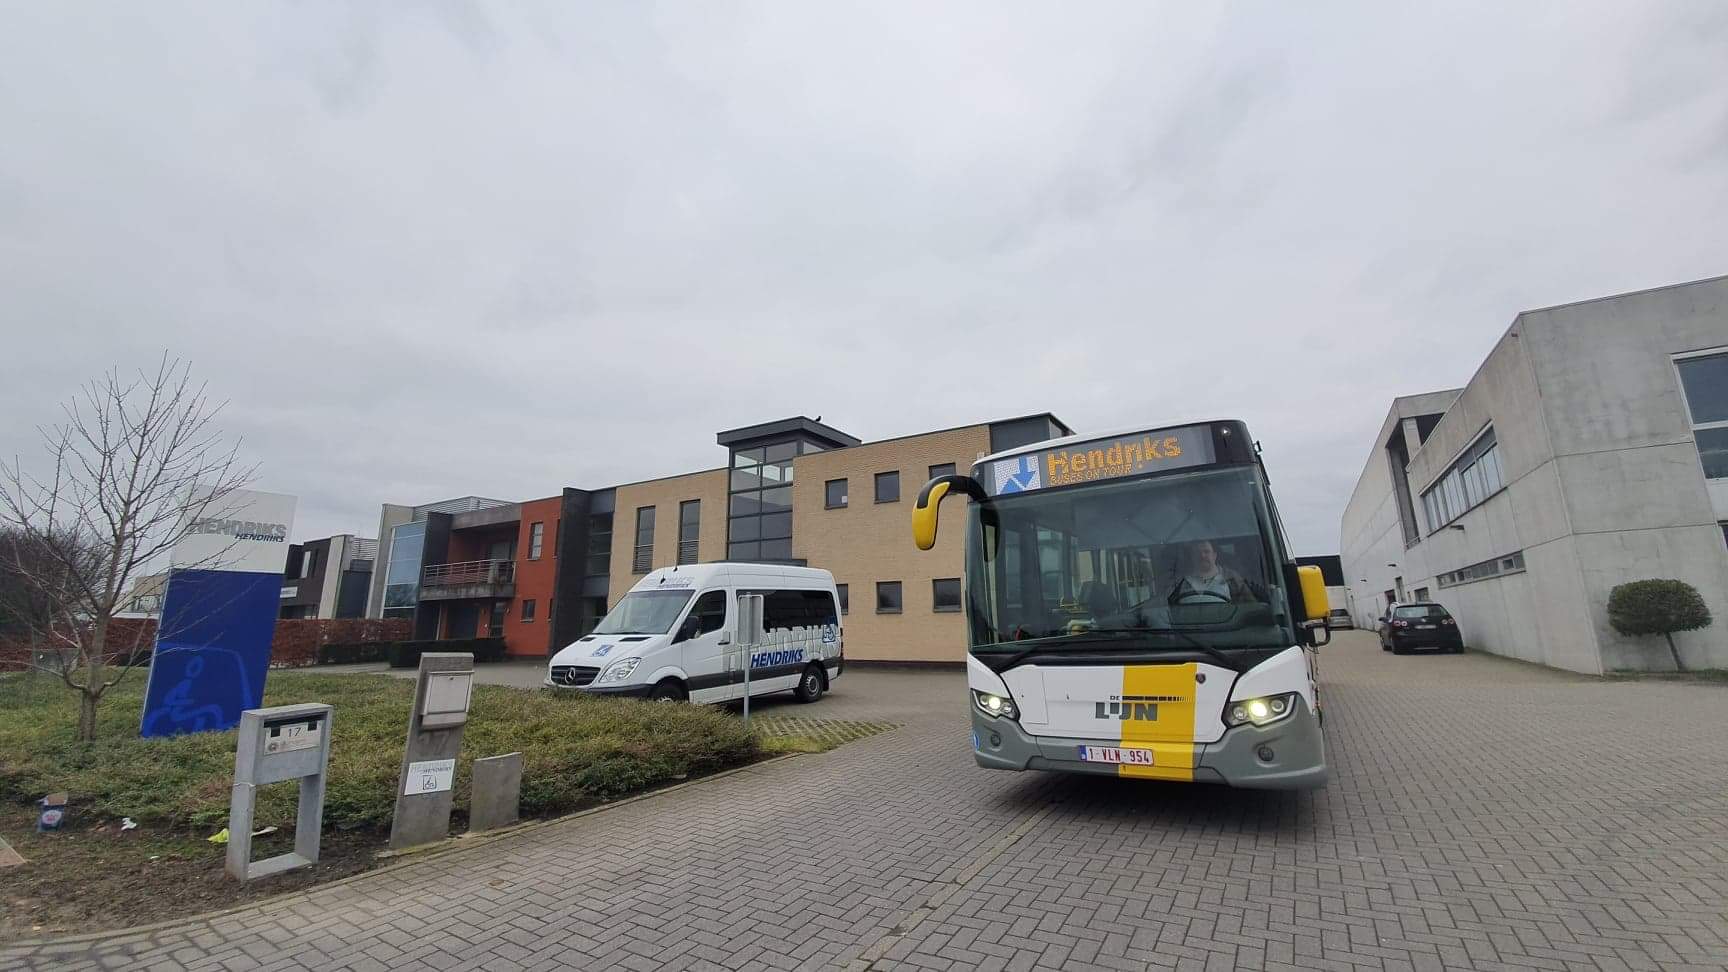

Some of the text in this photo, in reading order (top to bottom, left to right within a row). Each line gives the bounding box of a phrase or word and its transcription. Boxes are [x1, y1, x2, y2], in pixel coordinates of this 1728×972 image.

[1047, 434, 1182, 475] Hendriks
[234, 533, 285, 542] HENDRIKS
[750, 648, 804, 669] HENDRIKS
[289, 727, 302, 737] 17
